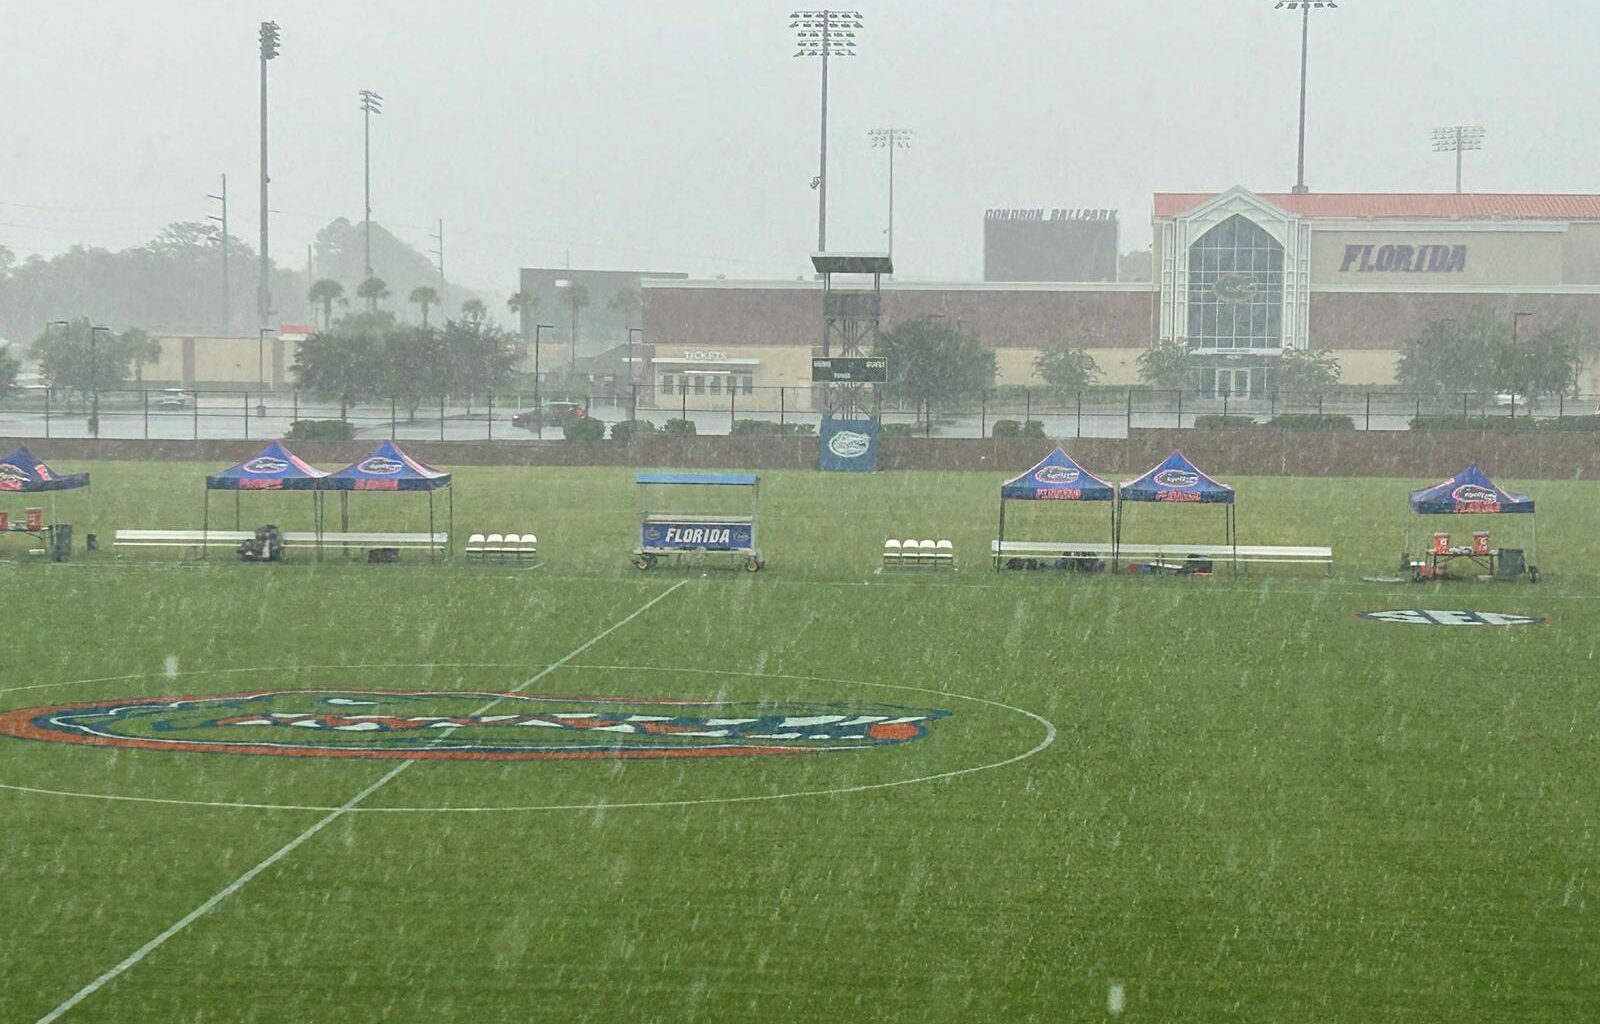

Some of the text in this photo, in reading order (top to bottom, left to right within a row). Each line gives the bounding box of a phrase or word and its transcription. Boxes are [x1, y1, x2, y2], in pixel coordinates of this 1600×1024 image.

[1338, 244, 1467, 272] FLORIDA
[684, 350, 728, 360] TICKETS
[665, 527, 730, 544] FLORIDA
